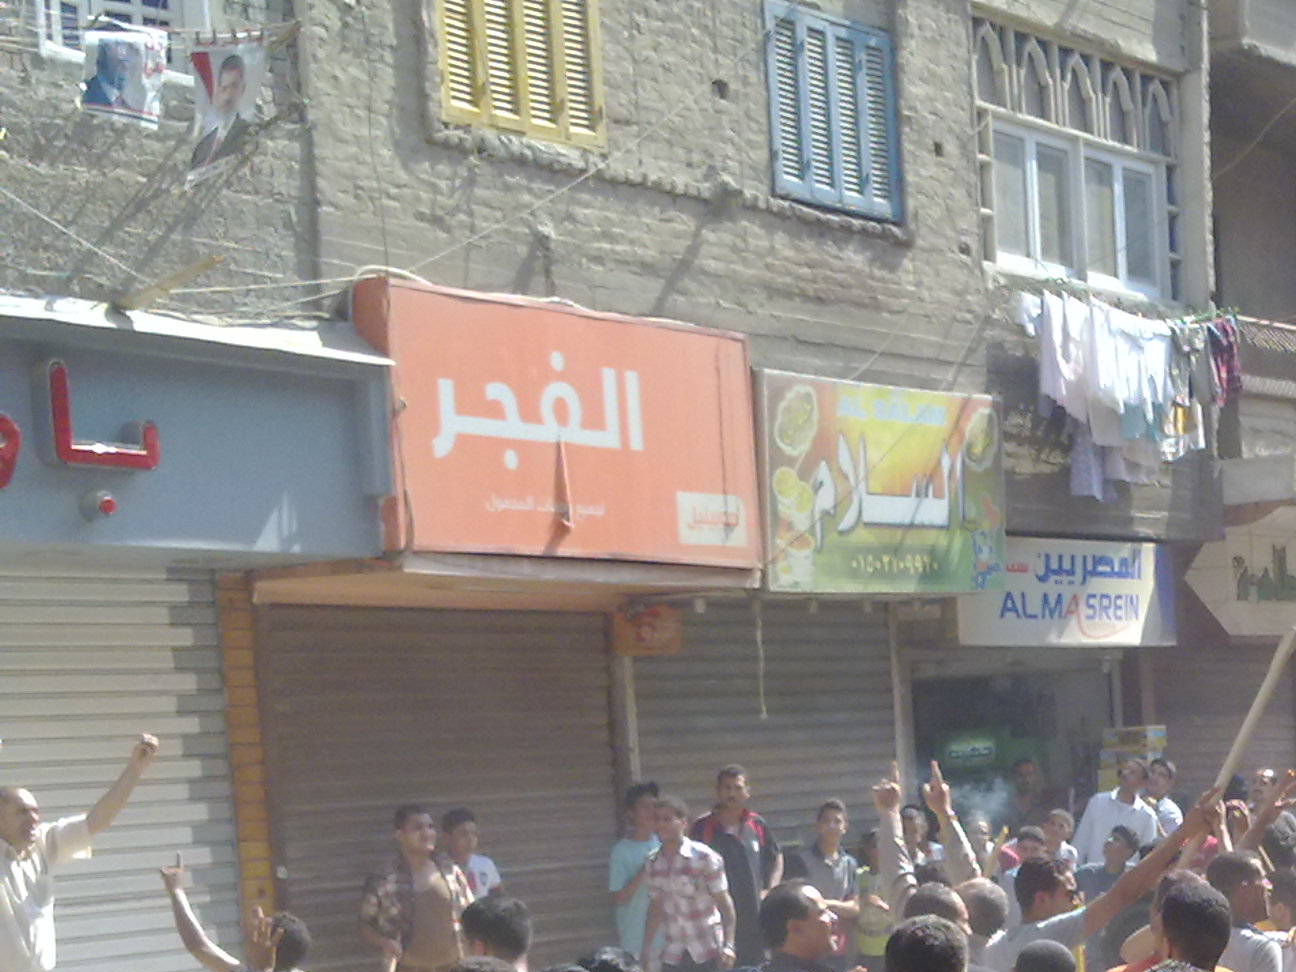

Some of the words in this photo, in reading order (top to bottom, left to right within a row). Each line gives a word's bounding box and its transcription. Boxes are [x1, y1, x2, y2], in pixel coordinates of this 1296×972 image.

[432, 350, 644, 470] الفجر
[812, 432, 966, 554] السلام
[999, 591, 1140, 622] ALMASREIN
[1035, 548, 1141, 586] المصريين
